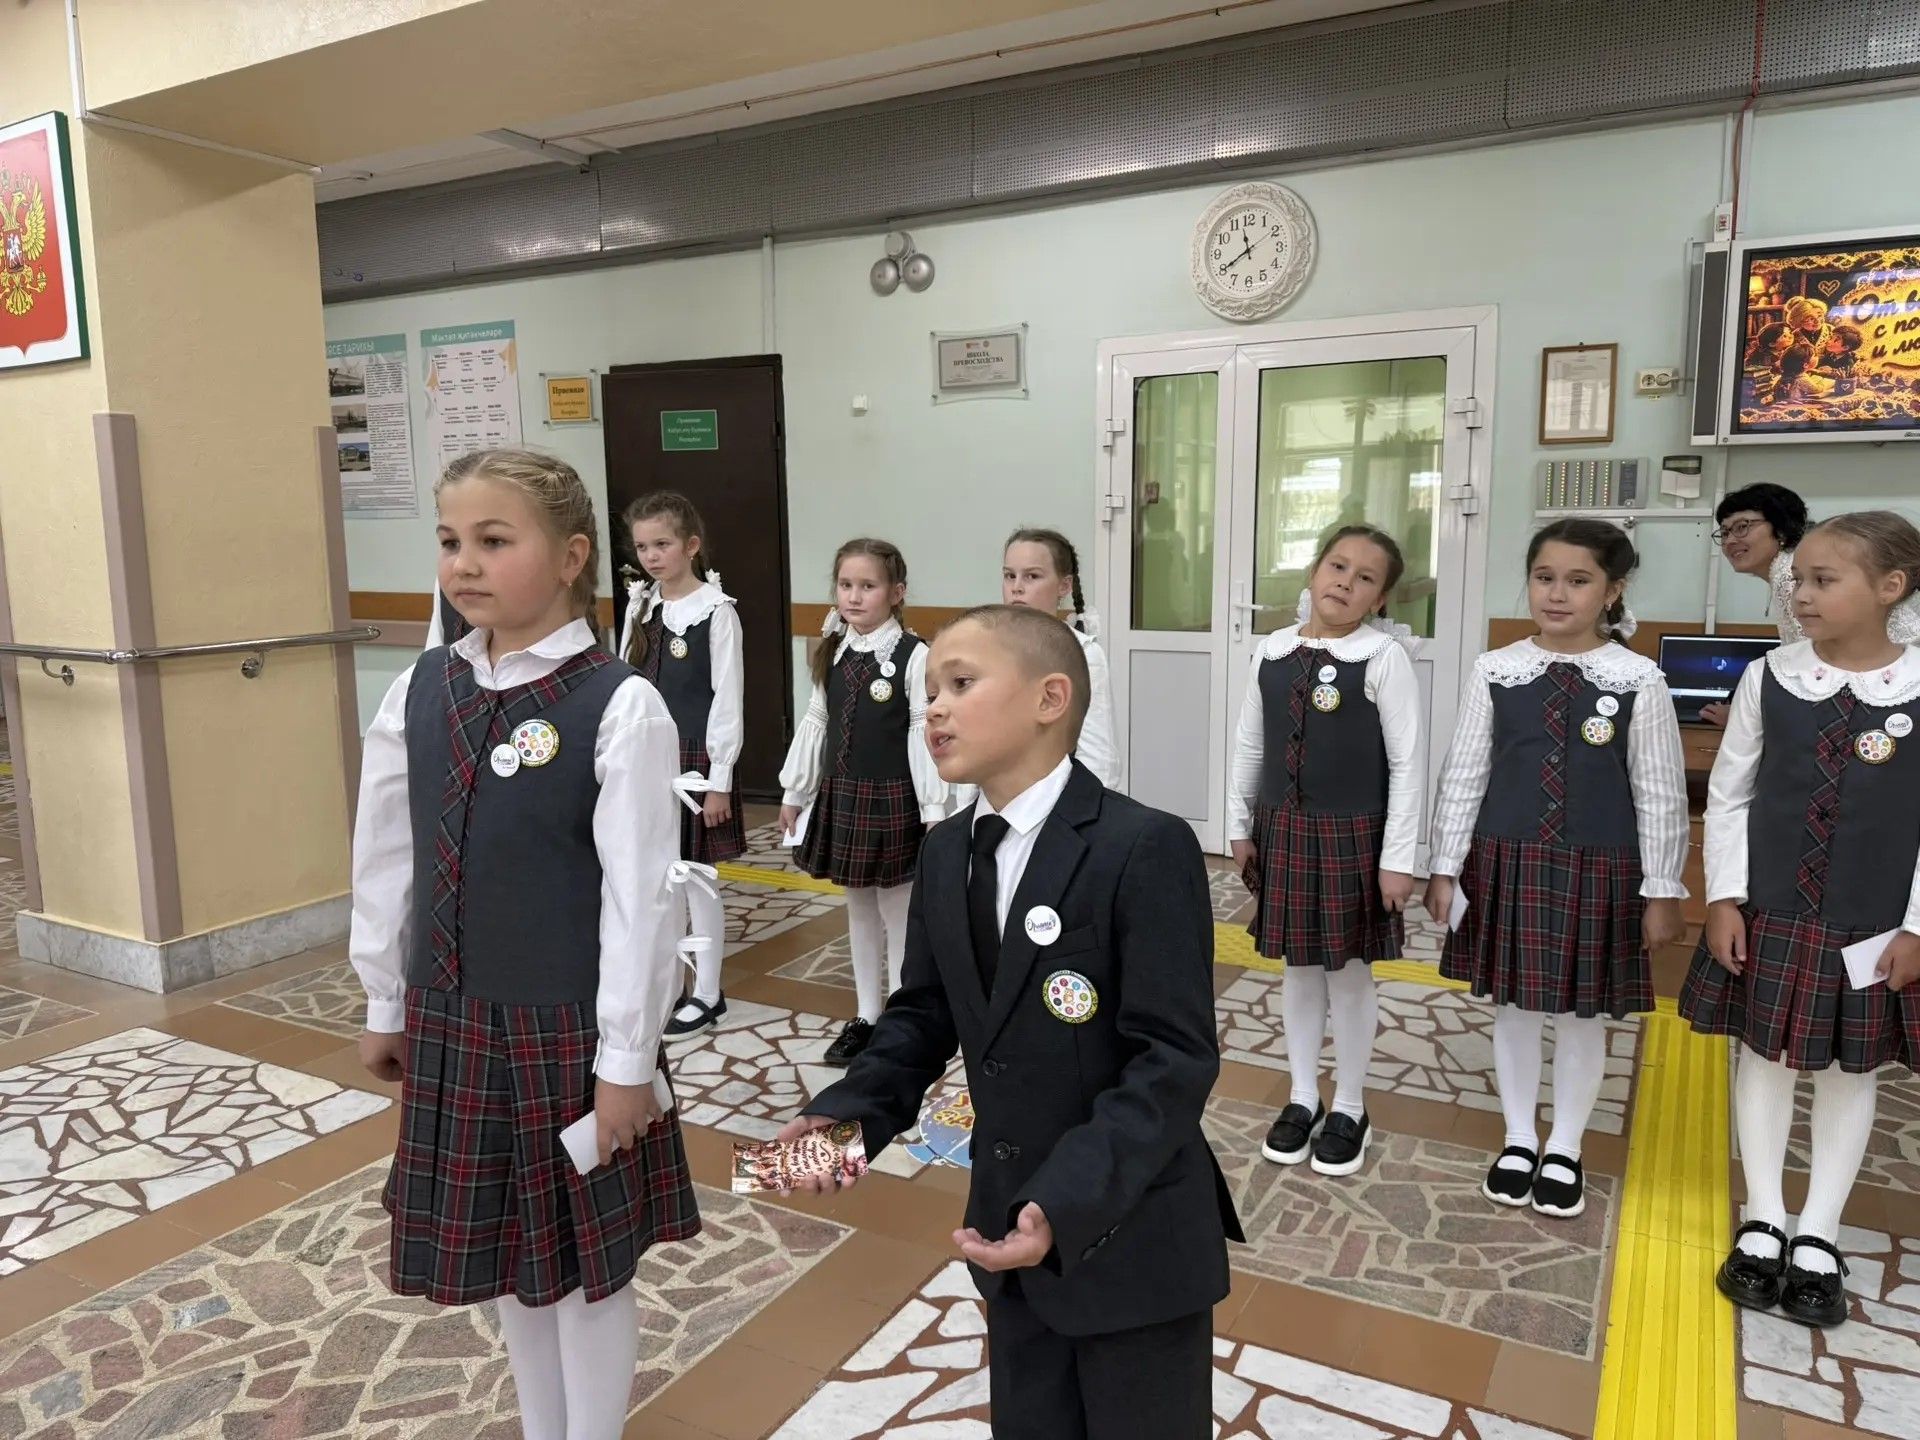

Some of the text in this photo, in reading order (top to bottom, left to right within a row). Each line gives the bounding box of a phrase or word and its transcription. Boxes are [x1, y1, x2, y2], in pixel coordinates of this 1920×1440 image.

[1230, 219, 1239, 231] 11
[1243, 213, 1255, 227] 12
[1261, 215, 1266, 227] 1
[1271, 225, 1280, 238] 2
[1218, 232, 1230, 245] 10
[1276, 241, 1284, 253] 3
[1214, 249, 1221, 260] 9
[1219, 263, 1227, 276] 8
[1270, 258, 1279, 269] 4
[1230, 273, 1238, 286] 7
[1244, 275, 1252, 287] 6
[1259, 269, 1267, 281] 5
[1850, 294, 1898, 325] От
[1874, 325, 1887, 338] с
[1872, 345, 1888, 358] и
